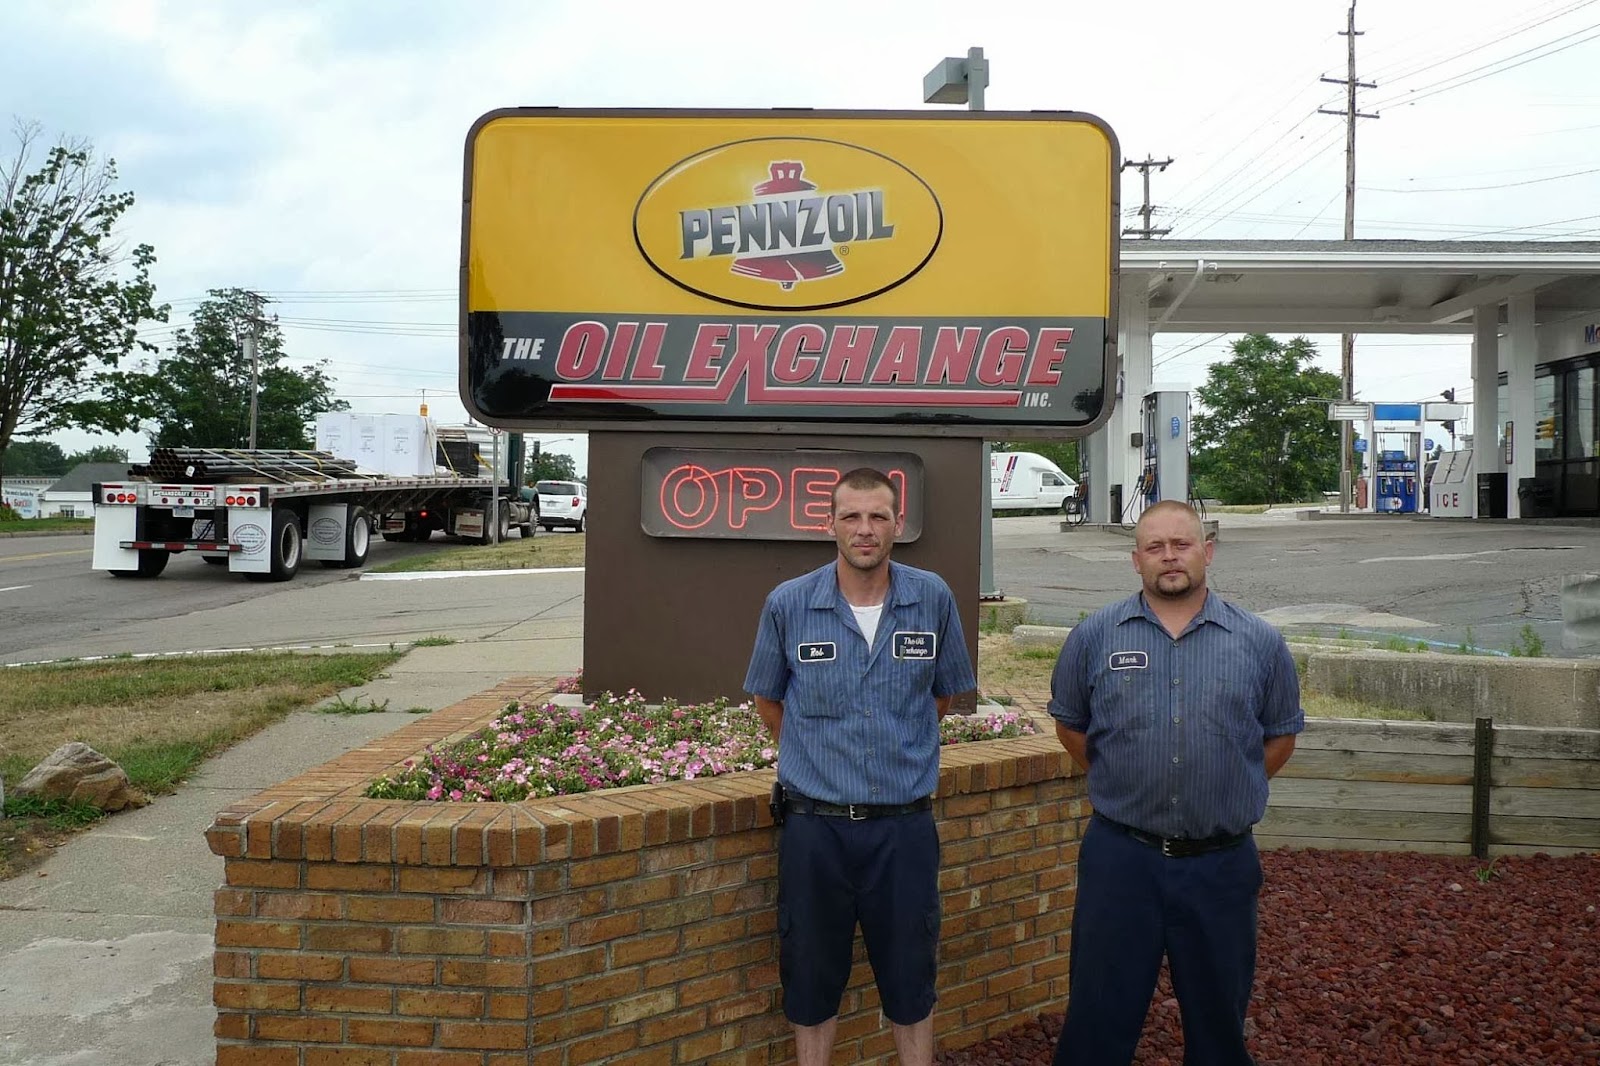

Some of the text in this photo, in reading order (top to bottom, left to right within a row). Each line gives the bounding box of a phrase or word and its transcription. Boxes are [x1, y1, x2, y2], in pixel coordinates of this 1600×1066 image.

[679, 189, 895, 260] PENNZOIL
[501, 320, 1075, 394] THE OIL EXCHANGE
[1024, 392, 1052, 408] INC.
[1436, 492, 1459, 508] ICE
[904, 637, 915, 645] The
[810, 647, 825, 657] Rob
[1118, 656, 1138, 665] Mark
